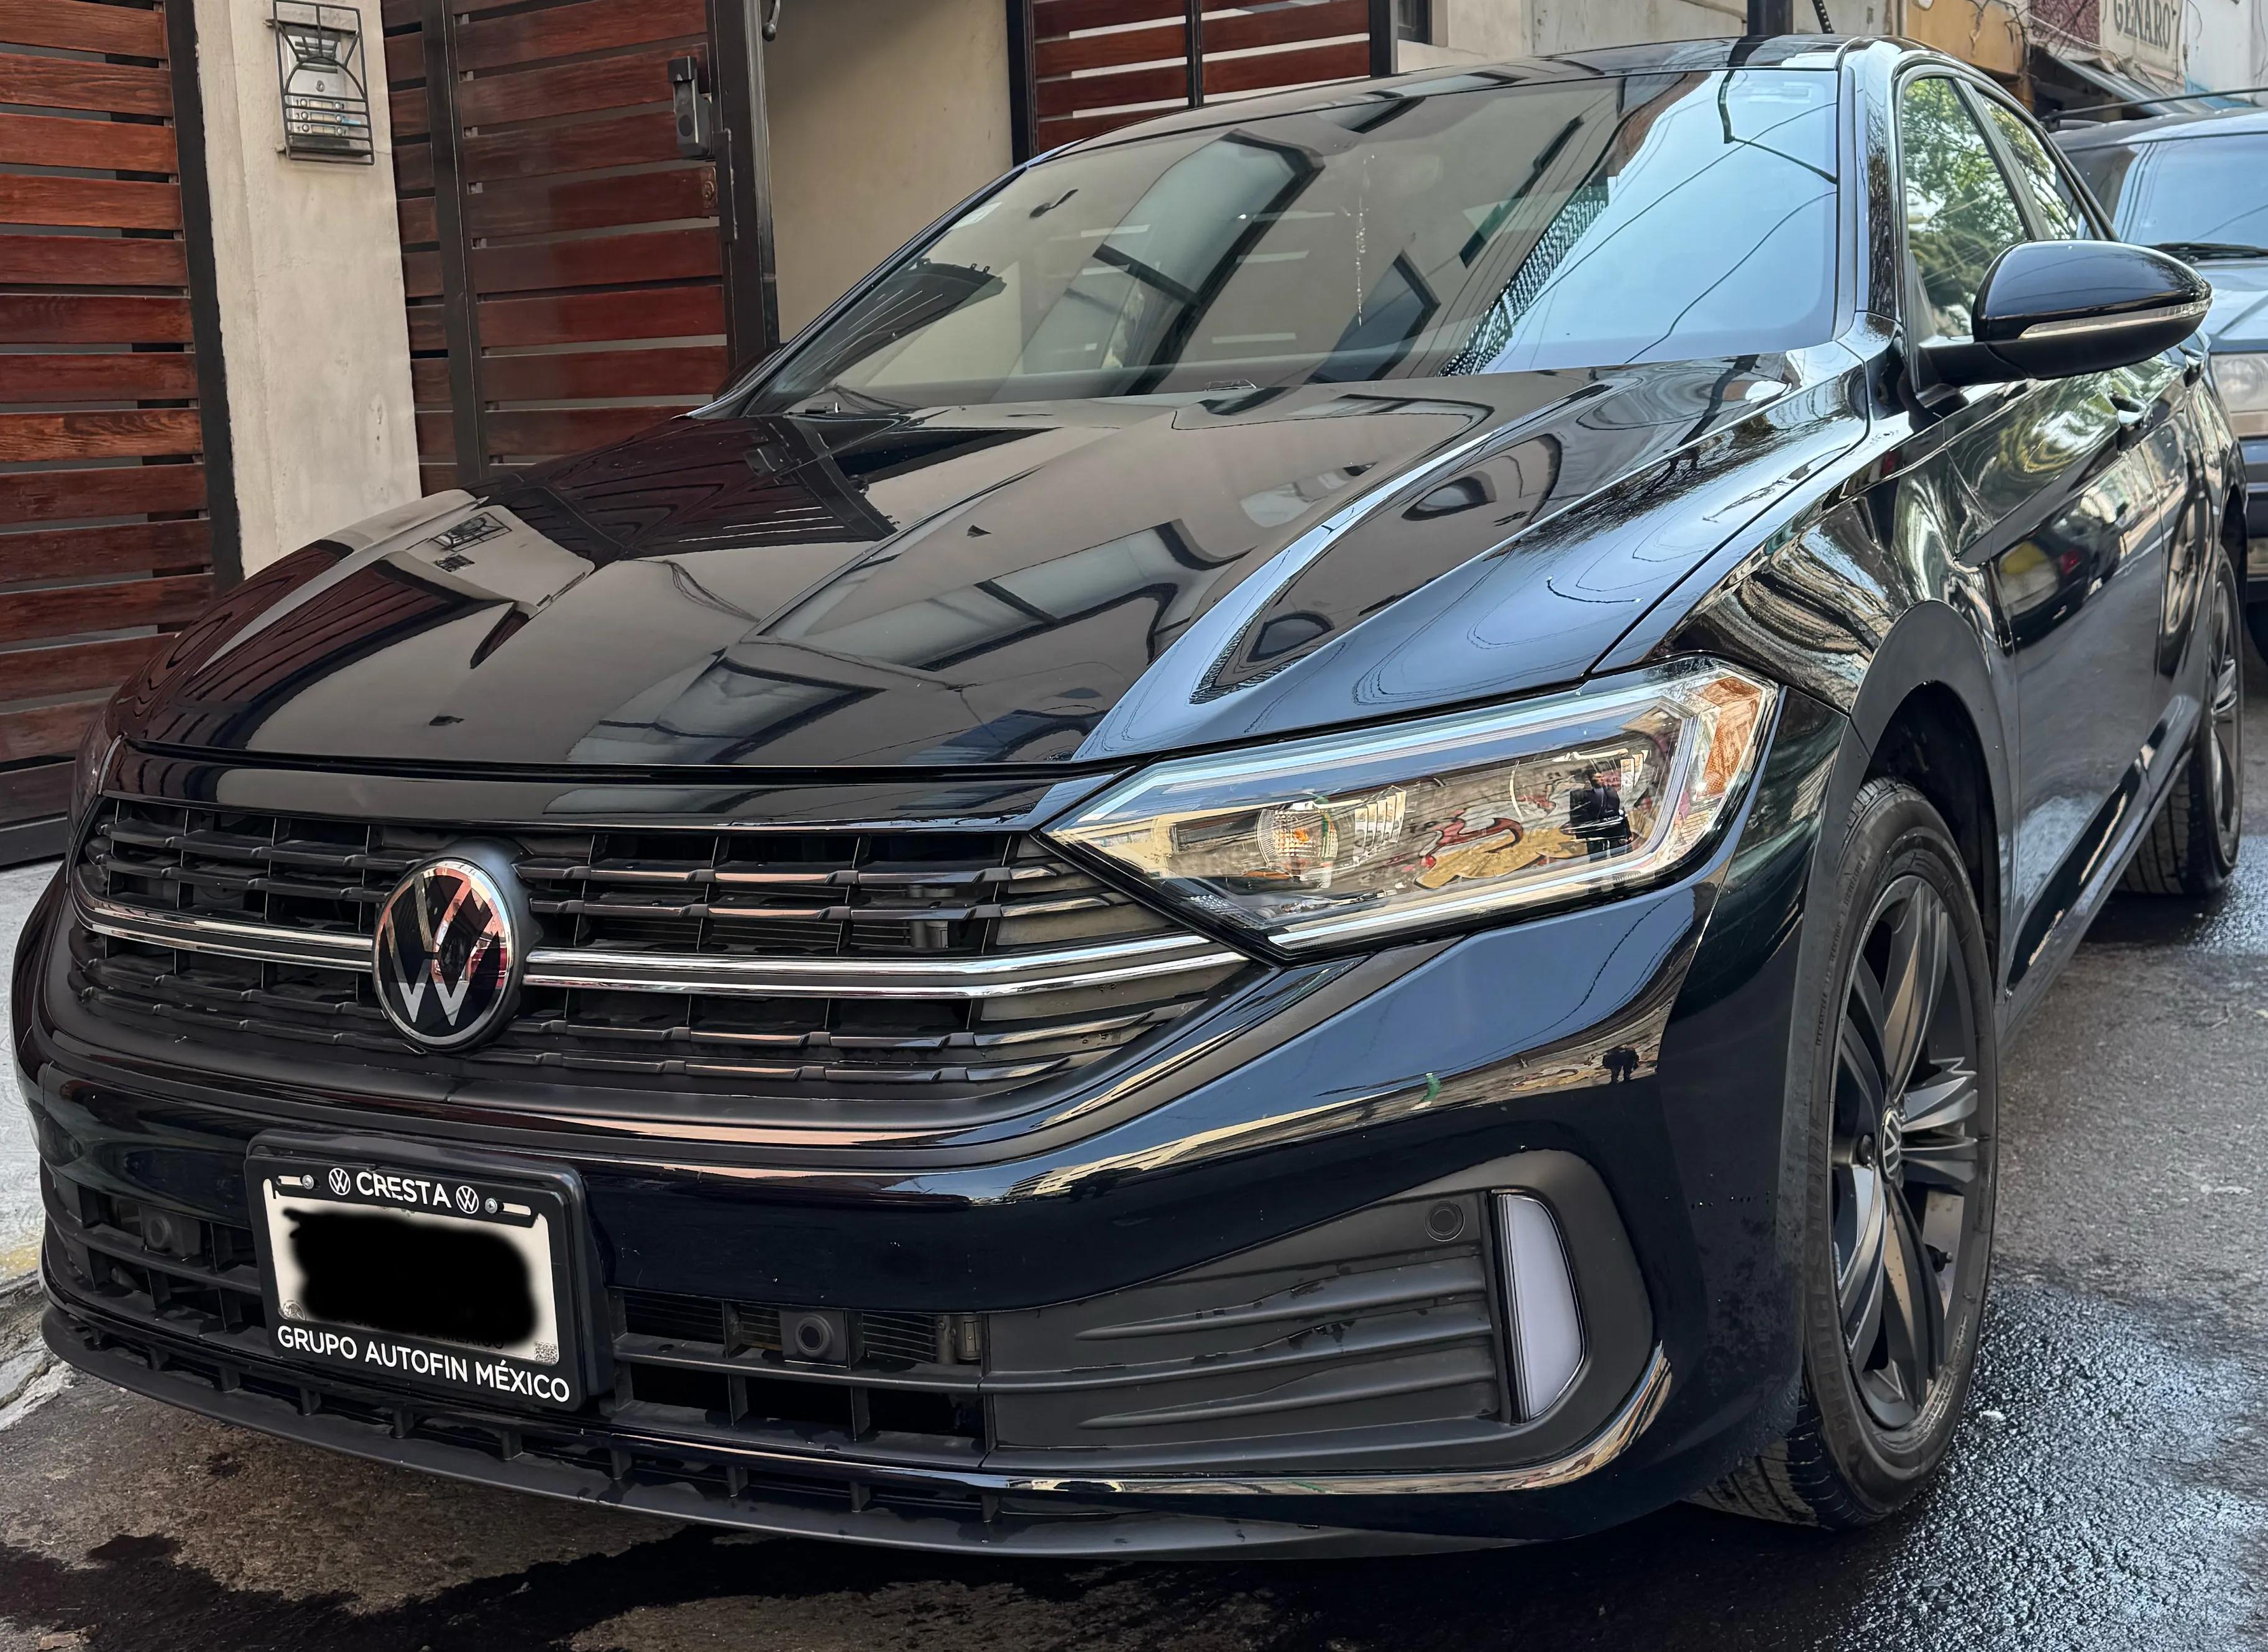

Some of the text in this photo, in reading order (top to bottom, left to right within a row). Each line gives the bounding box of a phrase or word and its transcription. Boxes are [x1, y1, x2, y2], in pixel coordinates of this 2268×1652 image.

[2114, 0, 2170, 50] GENARO
[356, 1172, 452, 1208] CRESTA
[278, 1326, 357, 1359] GRUPO
[365, 1341, 468, 1382] AUTOFIN
[475, 1359, 570, 1402] MÉXICO
